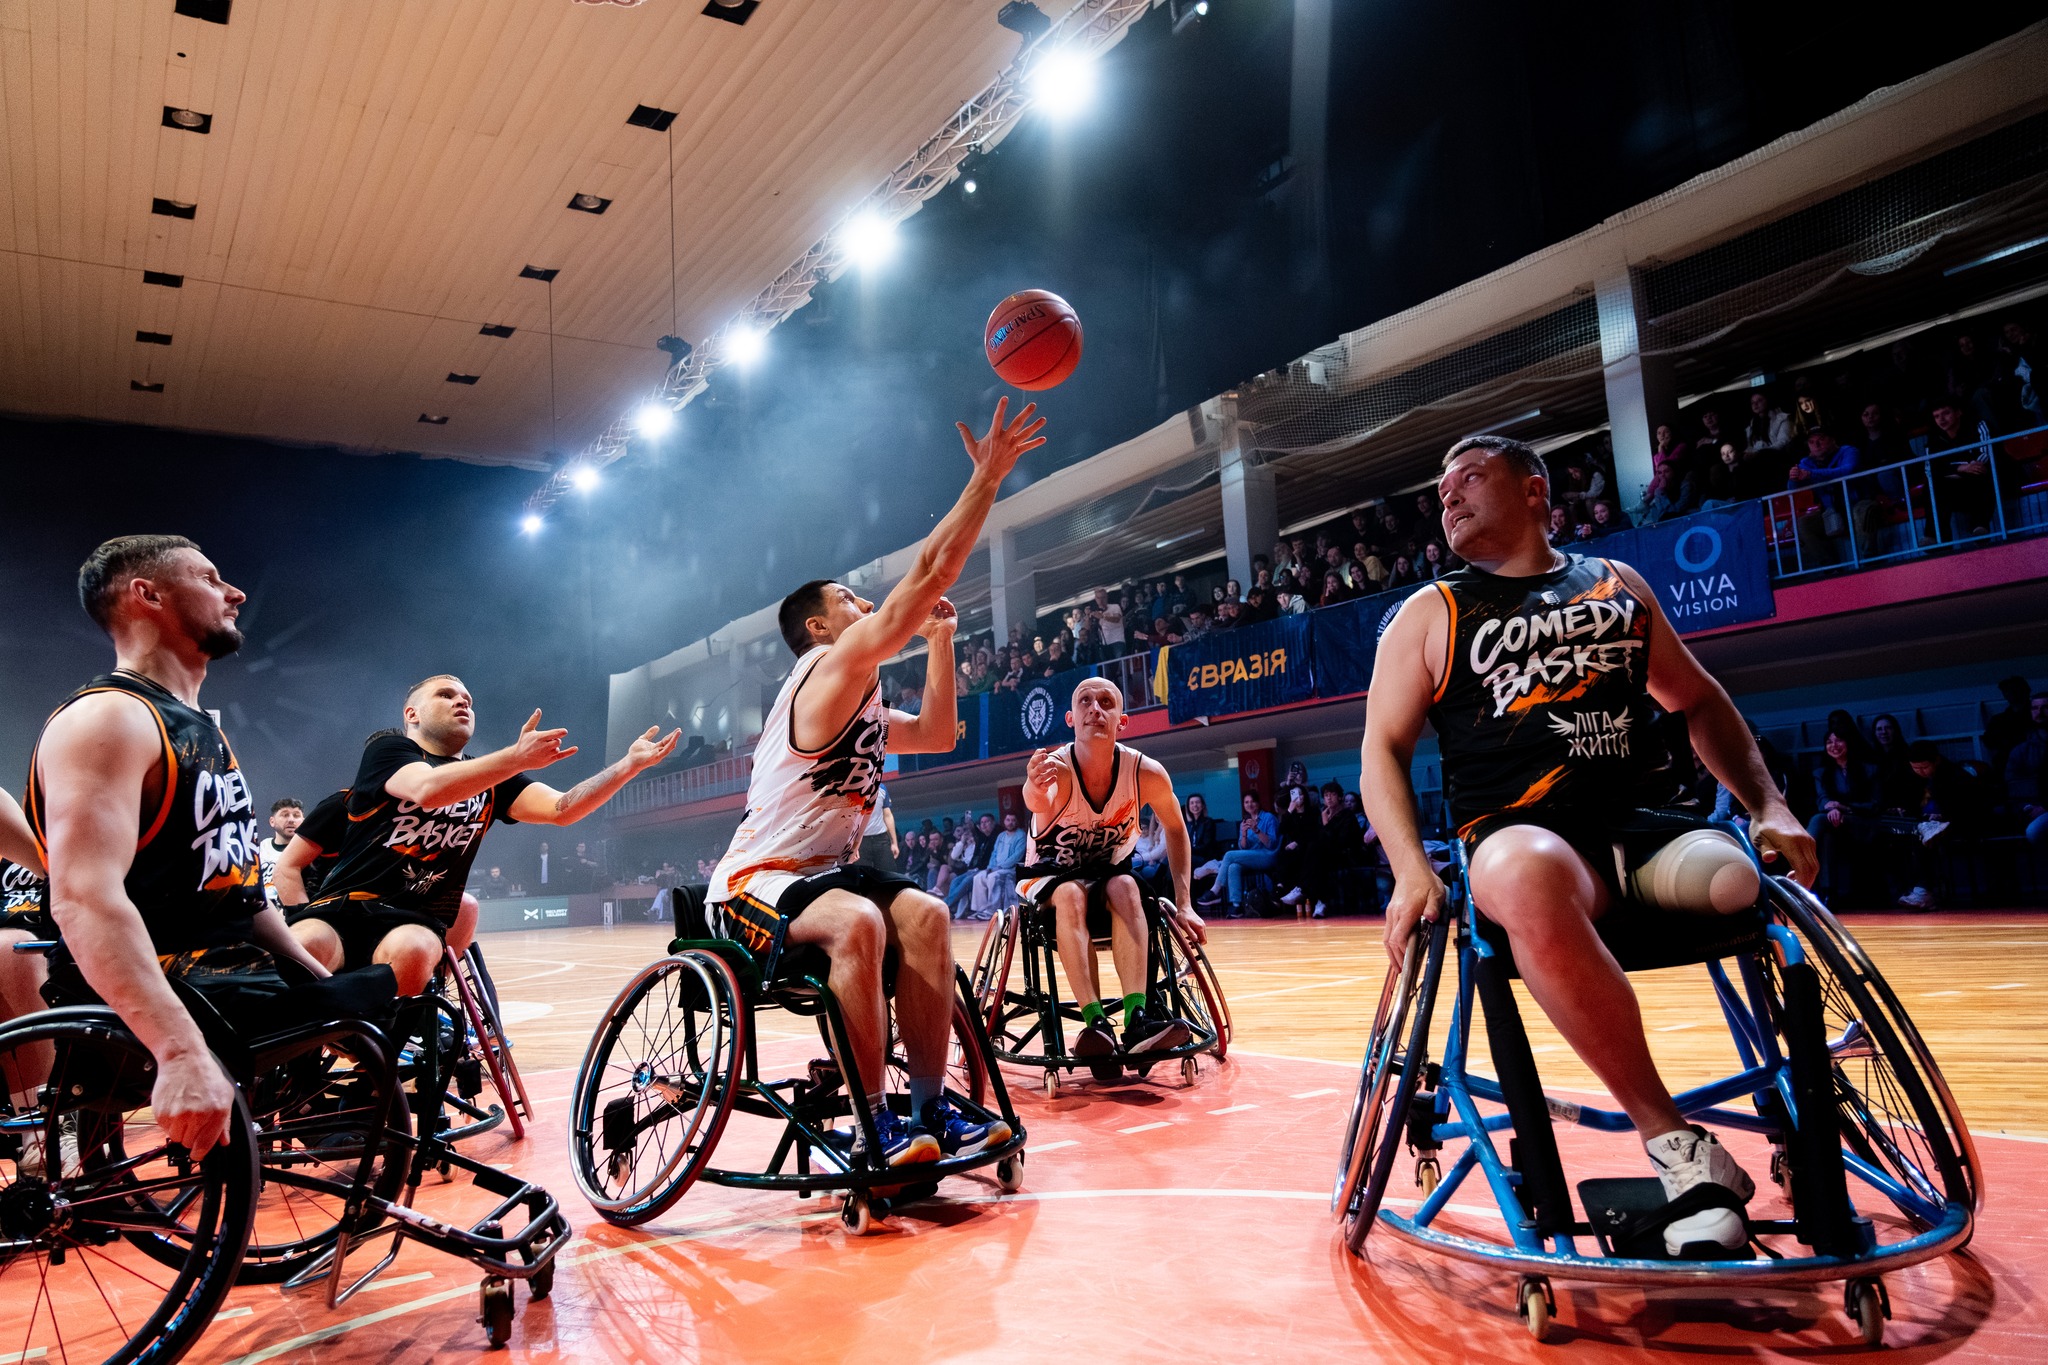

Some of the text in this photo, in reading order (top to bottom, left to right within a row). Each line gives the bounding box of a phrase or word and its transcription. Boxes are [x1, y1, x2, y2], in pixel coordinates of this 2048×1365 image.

[989, 304, 1046, 353] SPALDING
[1669, 573, 1736, 602] VIVA
[1672, 594, 1738, 618] VISION
[1469, 599, 1635, 675] COMEDY
[1482, 639, 1644, 718] BASKET
[1573, 710, 1615, 737] ЛІГА
[1567, 731, 1630, 760] ЖИТТЯ
[382, 814, 484, 857] BASKET
[1055, 816, 1135, 850] COMEDY
